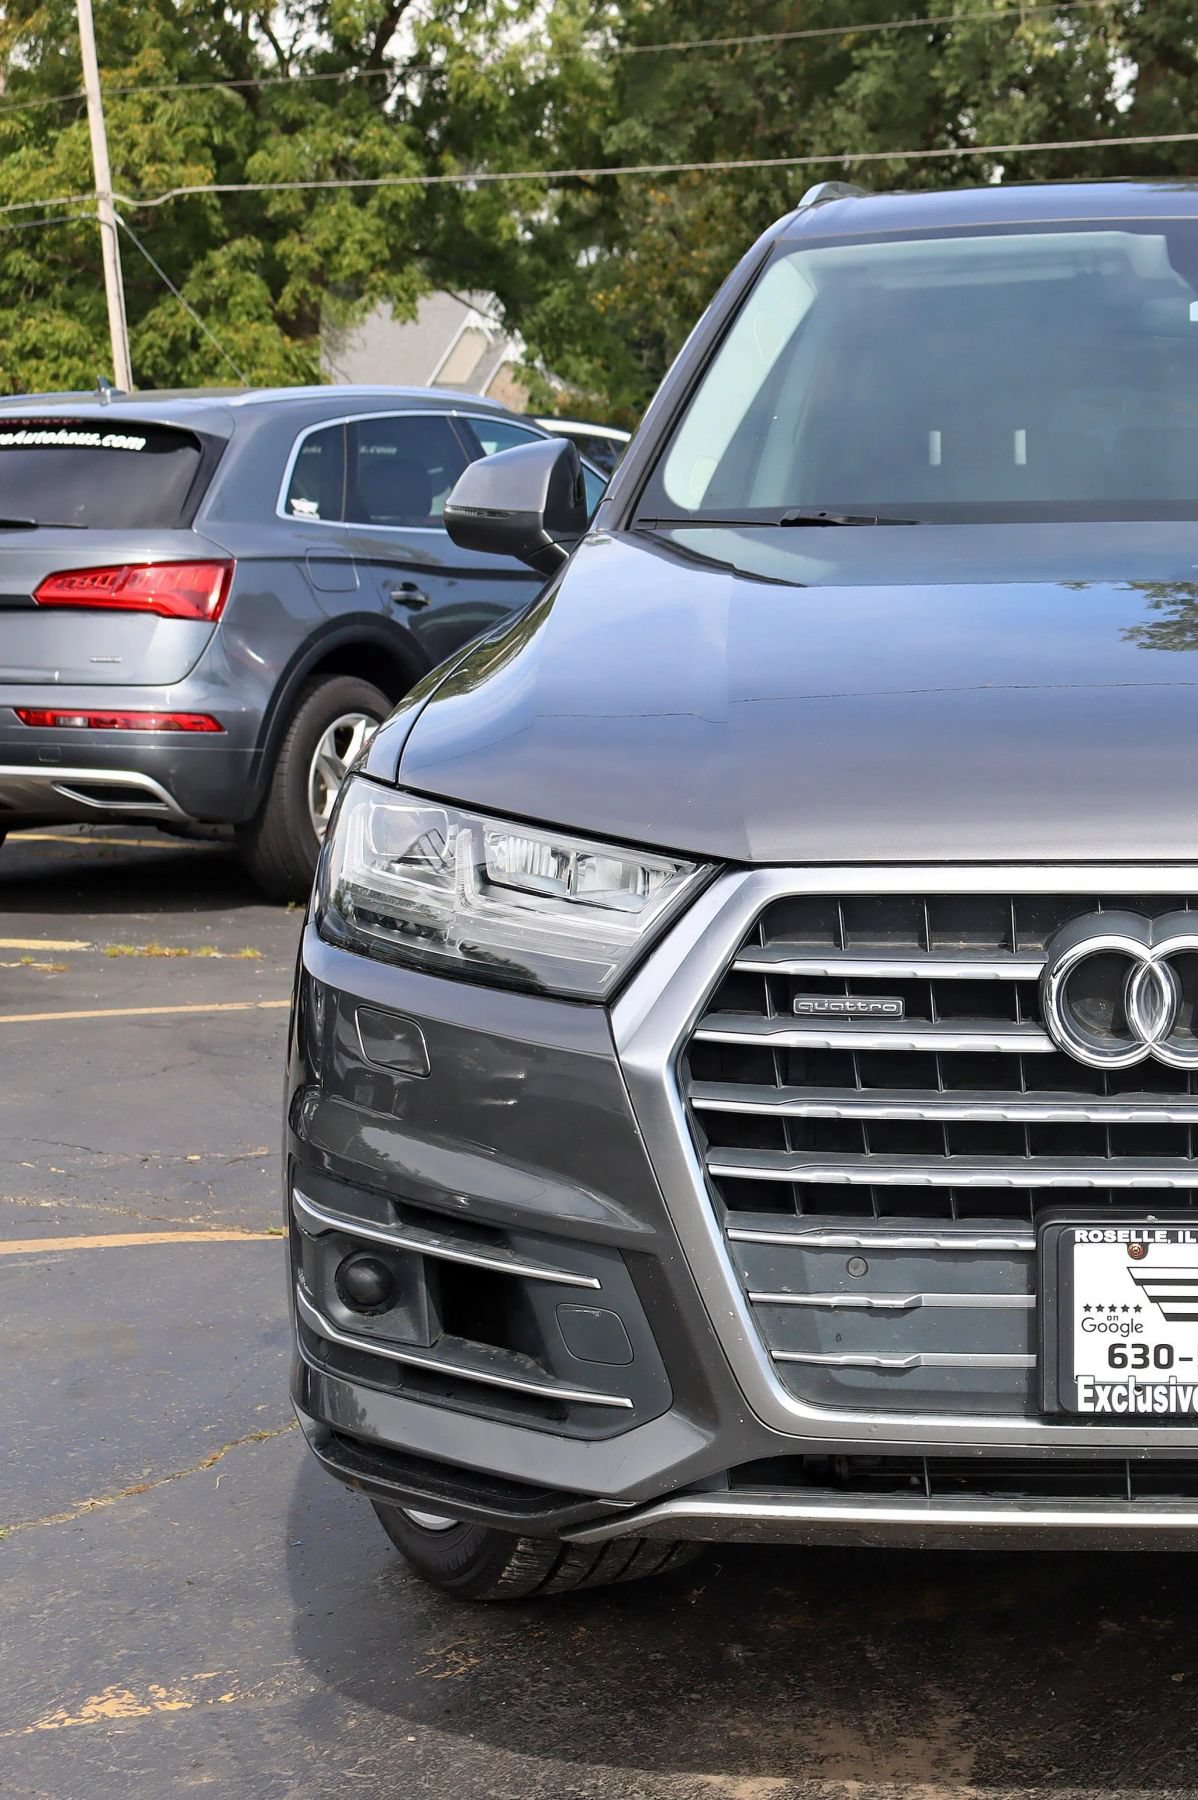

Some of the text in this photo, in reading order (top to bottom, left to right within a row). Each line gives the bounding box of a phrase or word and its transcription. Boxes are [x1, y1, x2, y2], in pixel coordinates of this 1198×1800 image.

[798, 1000, 897, 1012] quattro
[1074, 1229, 1197, 1244] ROSELLE, IL
[1081, 1316, 1144, 1337] Google
